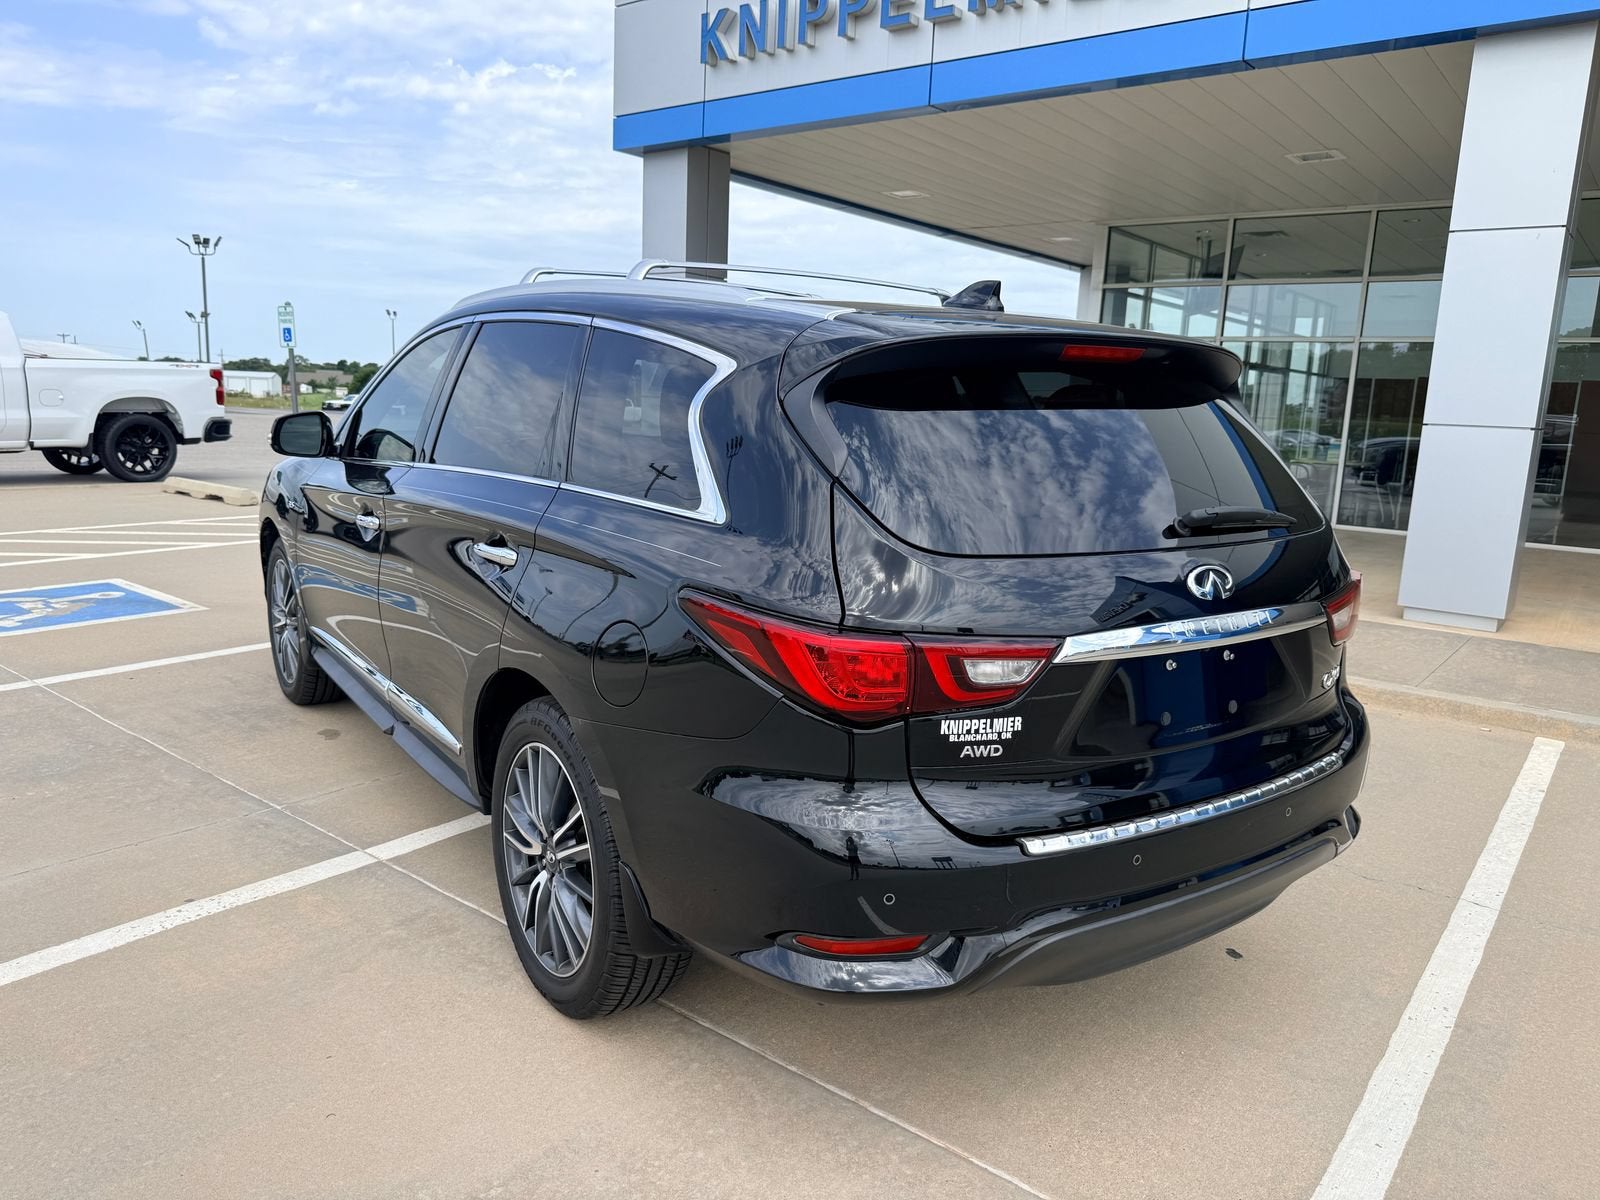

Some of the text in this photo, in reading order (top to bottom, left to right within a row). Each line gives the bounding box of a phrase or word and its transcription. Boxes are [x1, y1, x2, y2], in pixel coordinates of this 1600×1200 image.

[699, 0, 1023, 65] KNIPPE
[940, 717, 1022, 734] KNIPPELMIER
[949, 731, 1012, 741] BLANCHARD, OK
[960, 744, 1003, 757] AWD
